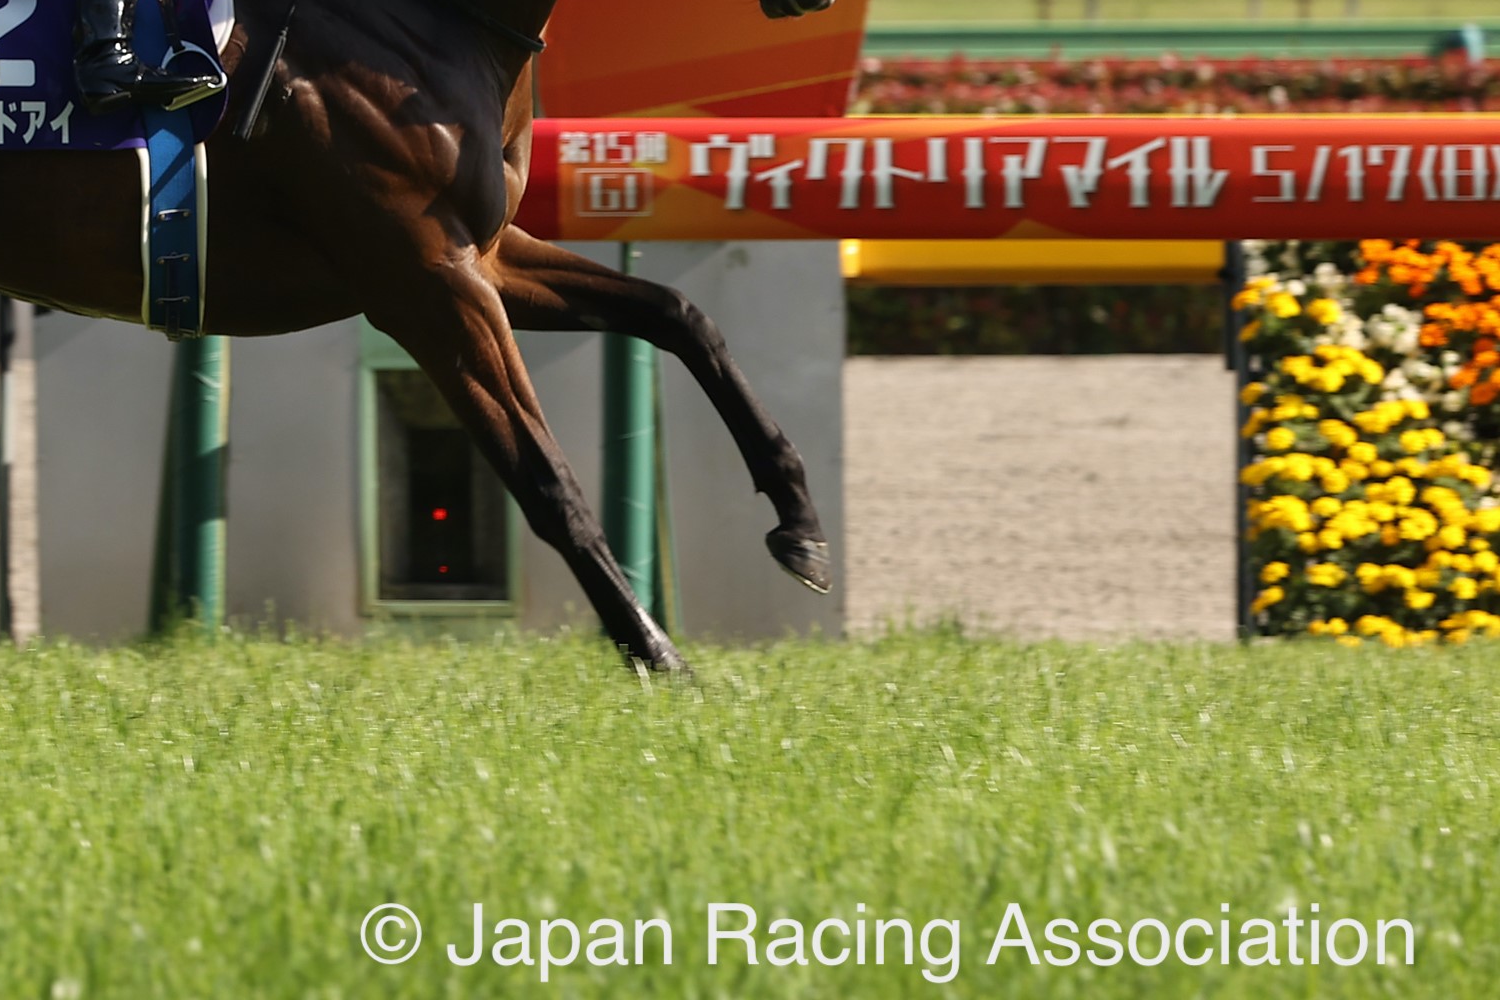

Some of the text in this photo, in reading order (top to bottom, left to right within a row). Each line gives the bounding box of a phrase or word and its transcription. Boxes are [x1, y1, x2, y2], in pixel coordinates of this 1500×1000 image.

[559, 131, 667, 164] 第15回
[689, 132, 1230, 210] ヴィクトリアマイル
